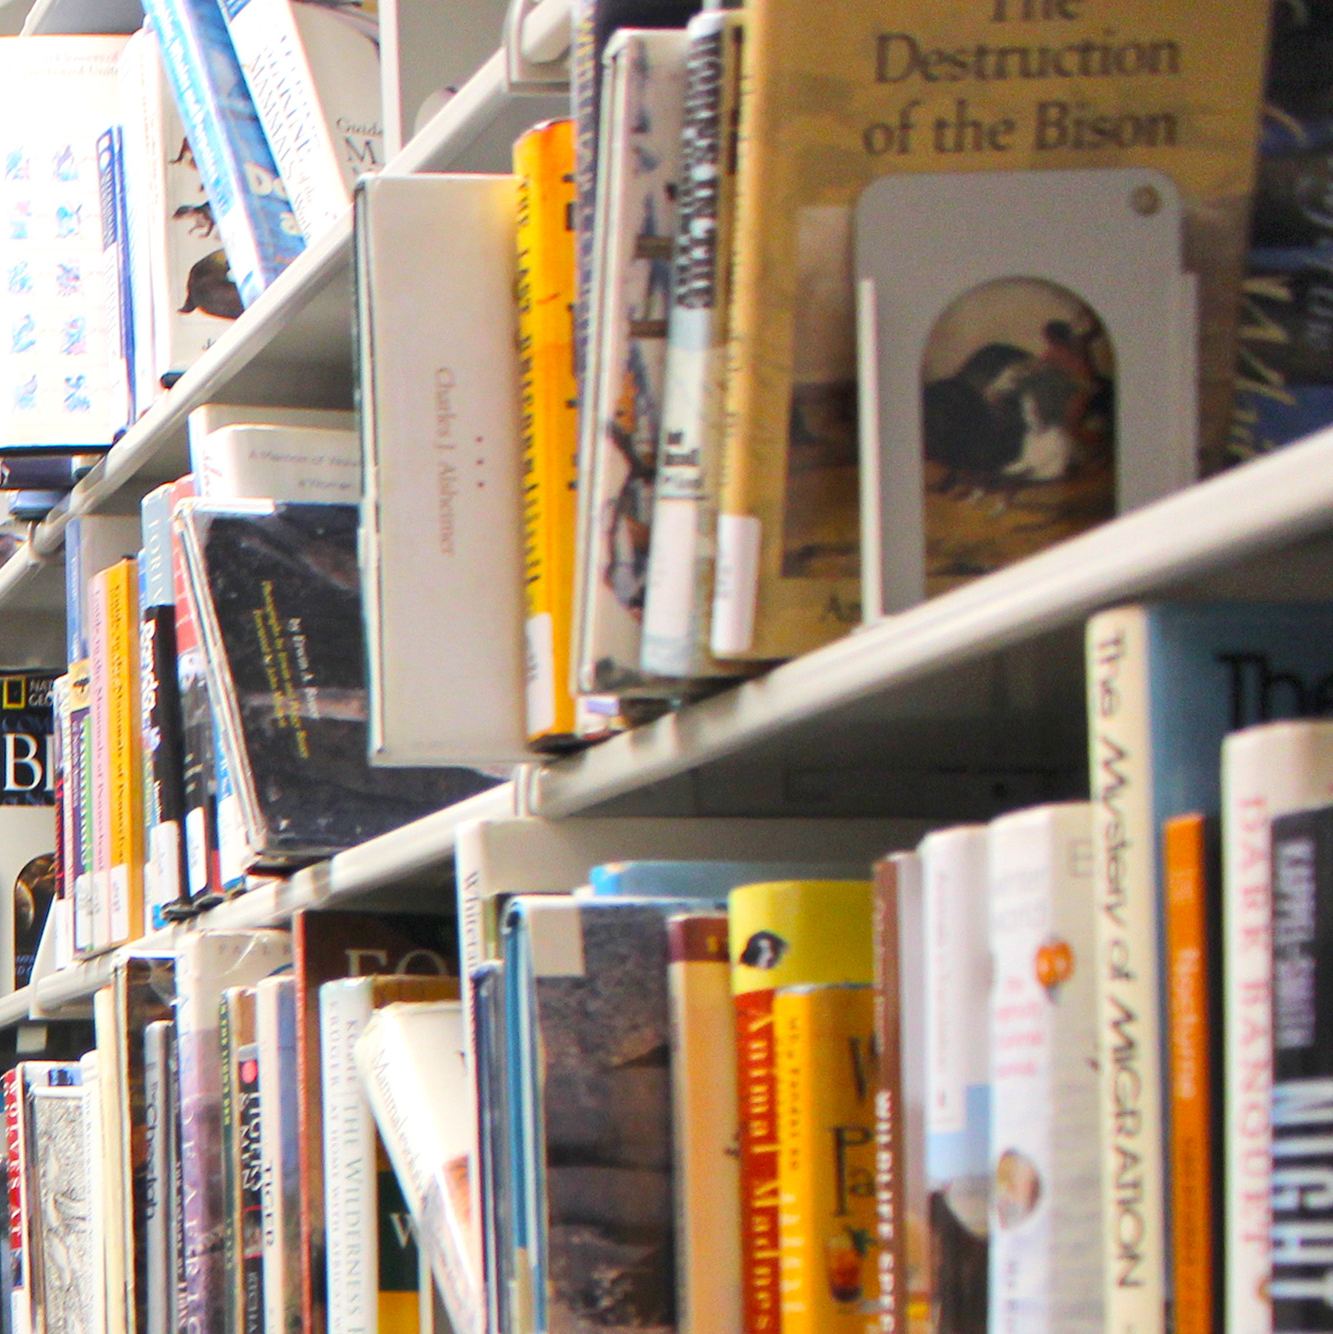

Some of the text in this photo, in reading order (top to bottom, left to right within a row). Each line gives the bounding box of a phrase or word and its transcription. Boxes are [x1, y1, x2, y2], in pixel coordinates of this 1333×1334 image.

[874, 31, 1181, 85] Destruction
[862, 100, 1178, 157] of the Bison
[435, 366, 455, 437] Charles
[1093, 630, 1147, 1289] The Mystery of MIGRATION
[747, 1010, 775, 1154] Animal
[1236, 796, 1270, 1257] DARK BANQUET
[263, 1159, 276, 1248] TIGER
[345, 1158, 363, 1316] WILDERNESS
